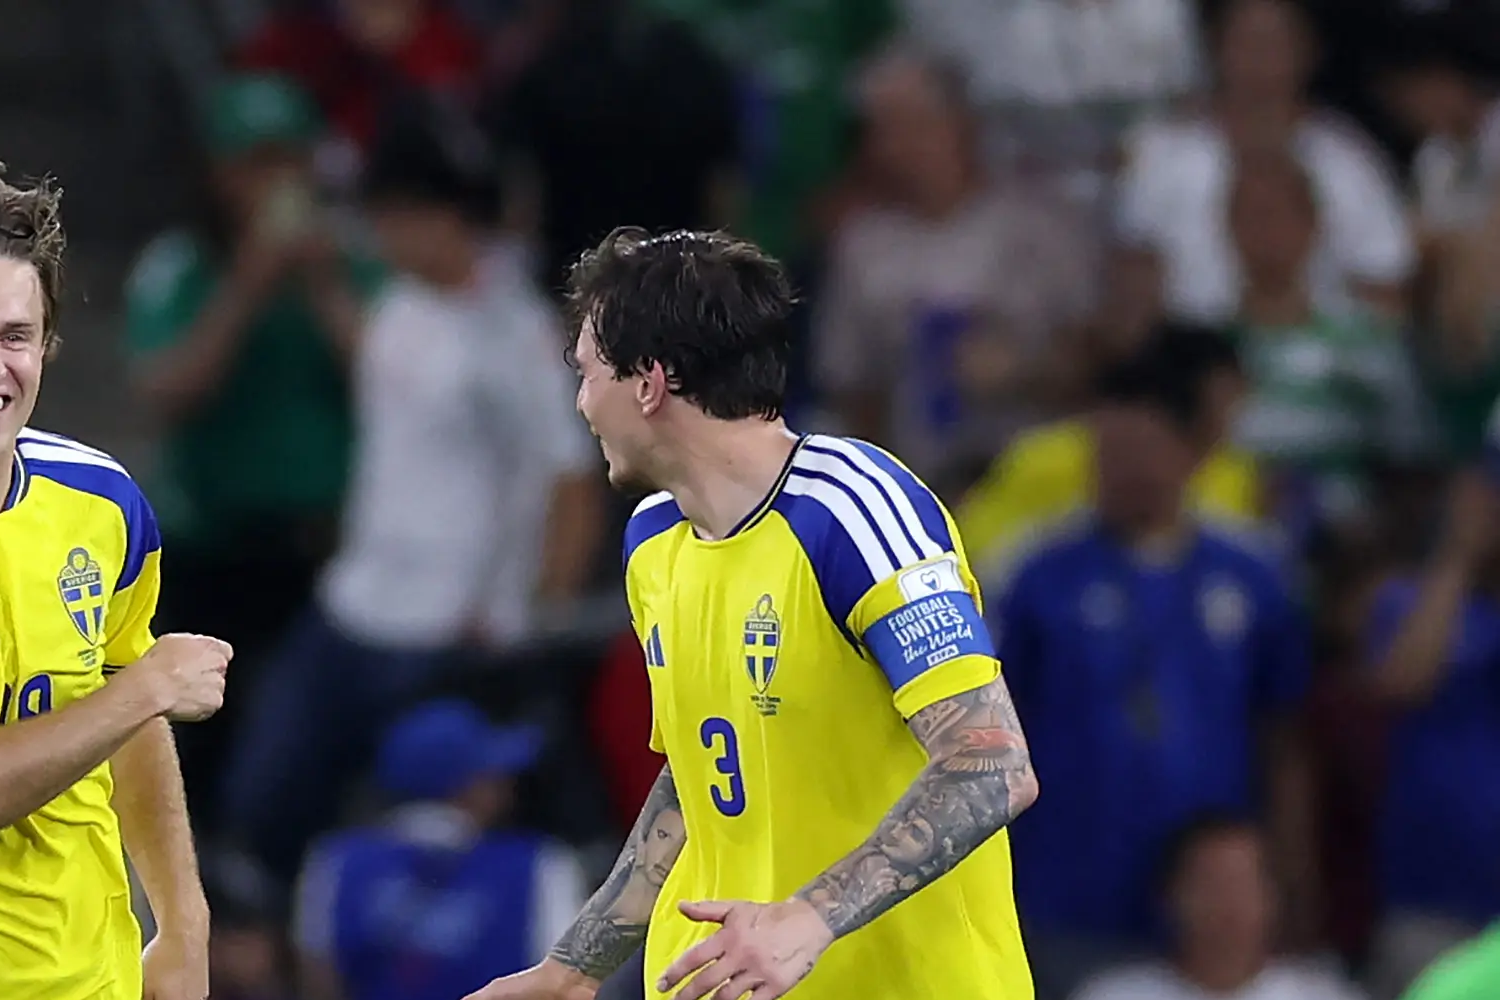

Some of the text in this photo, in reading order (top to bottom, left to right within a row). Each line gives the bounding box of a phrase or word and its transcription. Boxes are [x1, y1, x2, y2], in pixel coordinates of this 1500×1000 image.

[888, 595, 955, 632] FOOTBALL
[894, 607, 964, 647] UNITES
[904, 624, 974, 664] the World
[699, 716, 747, 817] 3
